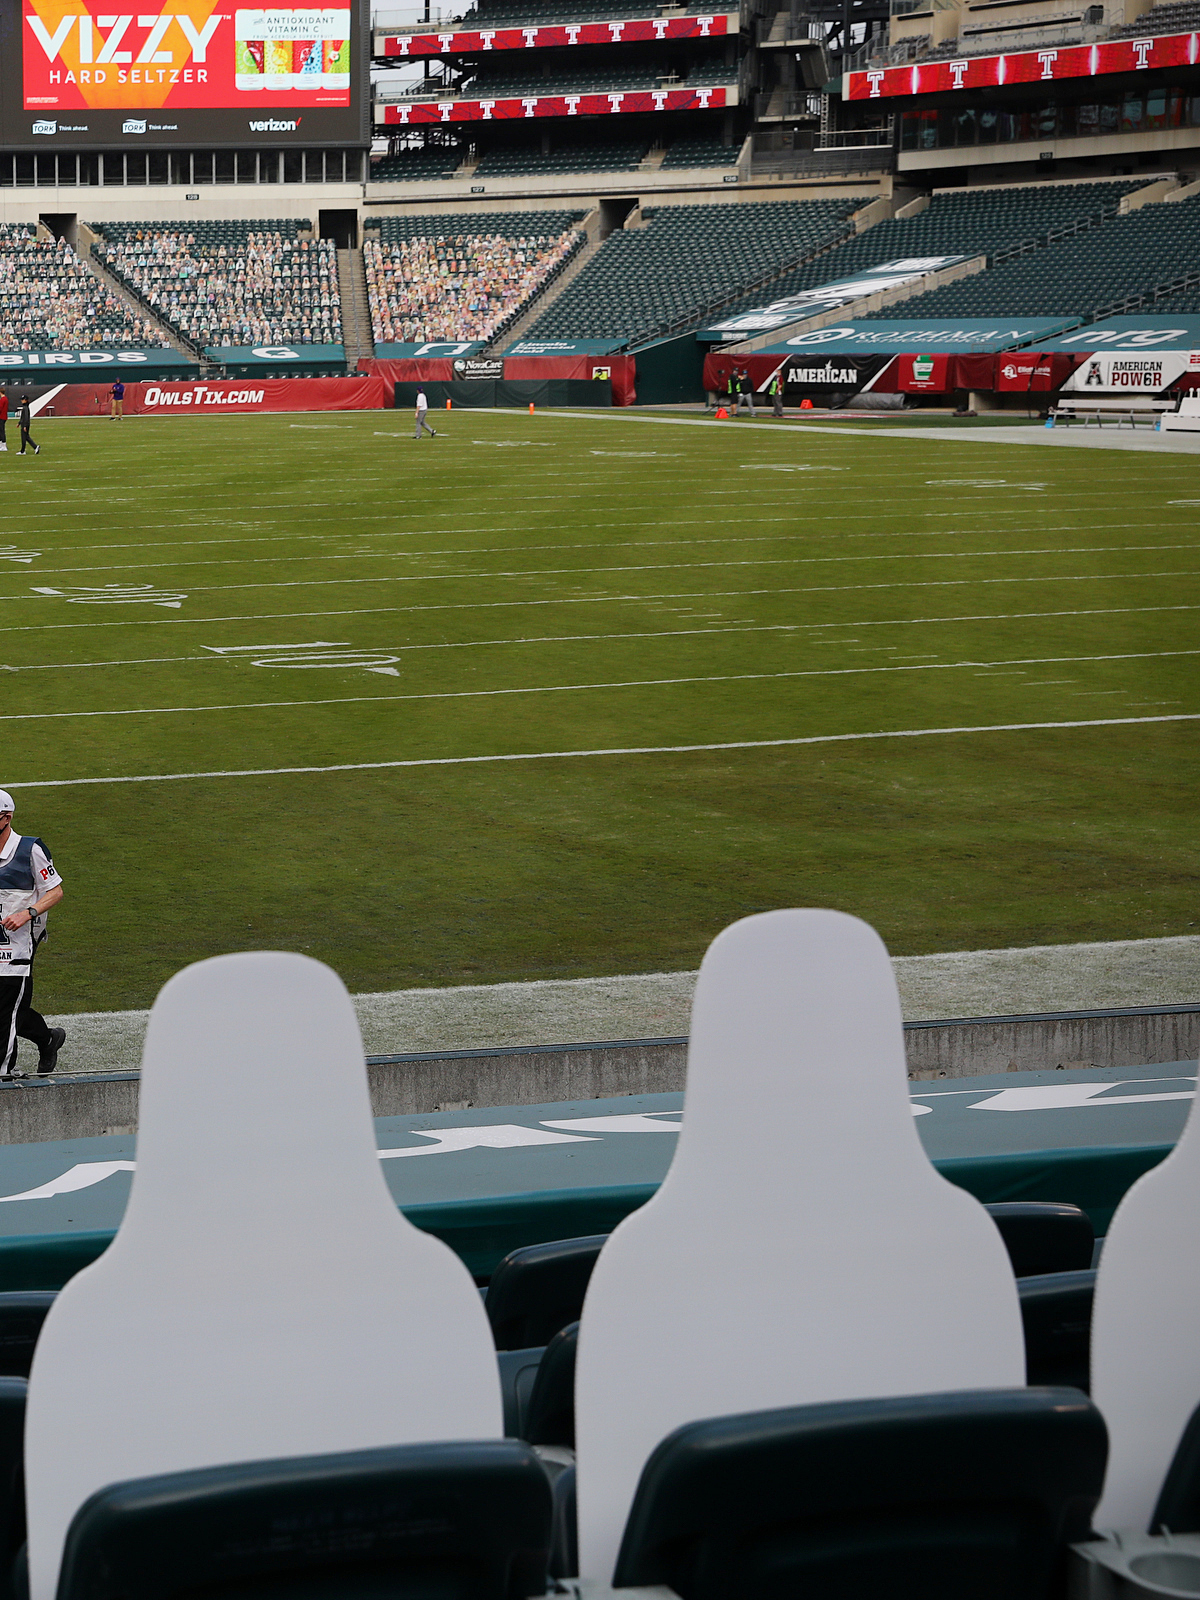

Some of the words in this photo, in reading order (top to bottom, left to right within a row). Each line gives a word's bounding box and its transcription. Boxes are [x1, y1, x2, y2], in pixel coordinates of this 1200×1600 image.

[266, 16, 334, 24] ANTIOXIDANT
[26, 14, 224, 64] VIZZY
[50, 70, 107, 84] HARD
[118, 69, 208, 84] SELTZER
[34, 124, 54, 132] TORK
[124, 124, 144, 132] TORK
[248, 118, 296, 132] verizon
[847, 330, 1034, 340] ROTHMAN
[1060, 330, 1188, 348] nrg
[466, 360, 503, 370] NovaCare
[1112, 362, 1163, 371] AMERICAN
[787, 368, 858, 384] AMERICAN
[1111, 372, 1162, 386] POW6R
[40, 865, 55, 880] P6
